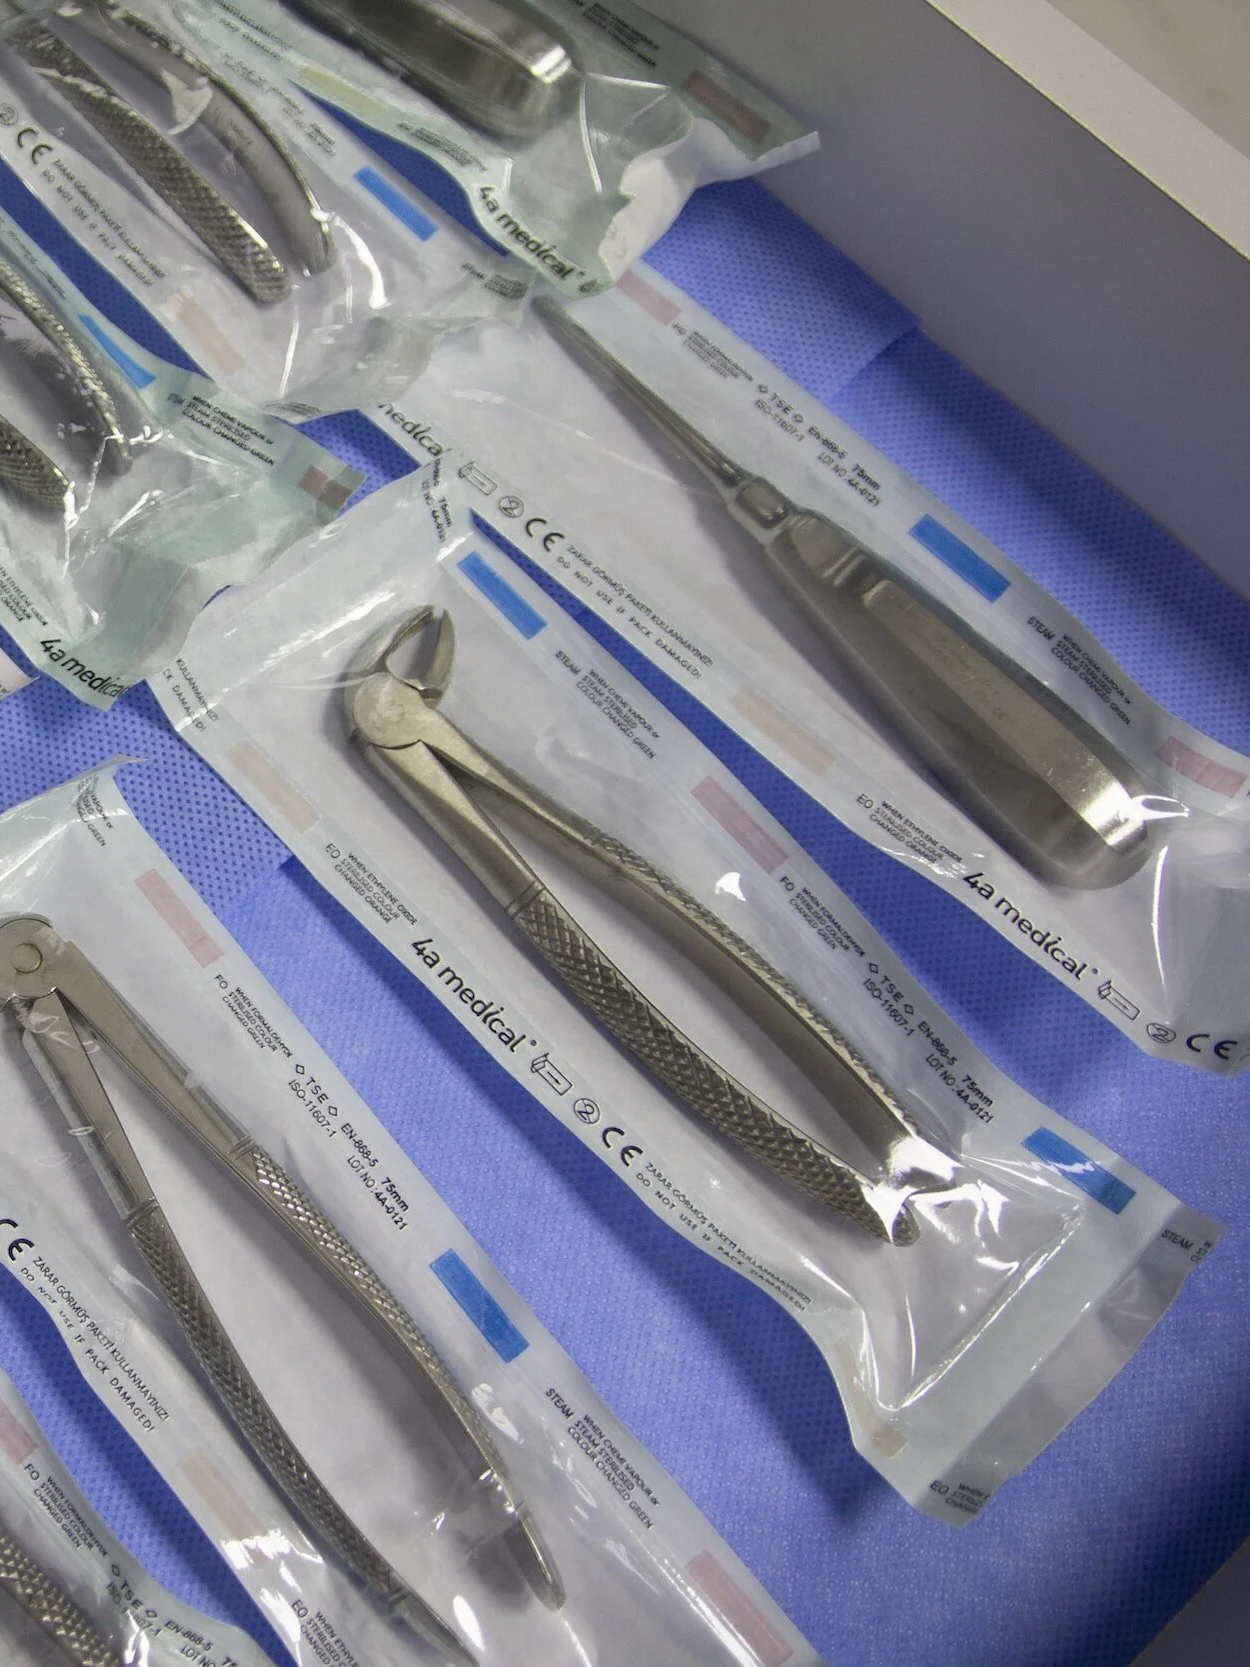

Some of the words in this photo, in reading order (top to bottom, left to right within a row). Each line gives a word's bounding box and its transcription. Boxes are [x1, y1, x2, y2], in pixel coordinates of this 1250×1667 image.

[495, 212, 576, 280] medical
[1026, 615, 1056, 642] STEAM
[39, 638, 67, 663] 4a
[554, 649, 582, 677] STEAM
[581, 674, 606, 698] STEAM
[588, 668, 610, 690] WHEN
[575, 680, 605, 710] COLOUR
[632, 736, 657, 760] GREEN
[855, 792, 875, 810] EO
[324, 842, 342, 860] EO
[333, 863, 367, 897] CHANGED
[363, 894, 393, 925] ORANGE
[347, 851, 369, 875] WHEN
[366, 872, 400, 906] ETHYLENE
[778, 875, 796, 893] FO
[371, 891, 401, 921] COLOUR
[800, 886, 823, 909] WHEN
[824, 924, 851, 953] COLOUR
[962, 871, 996, 901] 4a
[993, 896, 1088, 981] medical
[213, 973, 229, 990] FO
[234, 986, 254, 1009] WHEN
[410, 937, 441, 970] 4a
[436, 965, 527, 1054] medical
[227, 990, 258, 1026] STERILISED
[254, 1023, 279, 1053] COLOUR
[861, 977, 916, 1038] ISO-11607-1
[924, 1052, 946, 1073] LOT
[879, 974, 905, 1004] TSE
[916, 1020, 959, 1067] EN-868-5
[961, 1074, 994, 1108] 75mm
[287, 1078, 338, 1139] ISO-11607-1
[346, 1154, 366, 1174] LOT
[305, 1075, 330, 1105] TSE
[339, 1122, 380, 1168] EN-868-5
[380, 1176, 410, 1213] 75mm
[644, 1161, 673, 1191] ZARAR
[635, 1171, 652, 1188] DO
[654, 1189, 677, 1211] NOT
[678, 1212, 699, 1232] USE
[1160, 1228, 1195, 1251] STEAM
[32, 1255, 60, 1287] ZARAR
[19, 1266, 36, 1282] DO
[36, 1285, 59, 1305] NOT
[58, 1309, 75, 1330] USE
[73, 1333, 86, 1344] IF
[84, 1347, 111, 1376] PACK
[108, 1376, 156, 1433] DAMAGED!
[544, 1387, 575, 1420] STEAM
[23, 1462, 41, 1482] FO
[573, 1419, 601, 1450] STEAM
[594, 1446, 636, 1492] STERILISED
[582, 1413, 606, 1441] WHEN
[623, 1463, 654, 1498] VAPOUR
[46, 1475, 66, 1501] WHEN
[566, 1425, 599, 1463] COLOUR
[594, 1459, 632, 1502] CHANGED
[628, 1500, 655, 1530] GREEN
[32, 1487, 64, 1525] CHANGED
[60, 1522, 83, 1549] GREEN
[38, 1481, 72, 1521] STERILISED
[68, 1518, 95, 1552] COLOUR
[119, 1578, 144, 1611] TSE
[163, 1619, 214, 1652] EN-868-5
[290, 1598, 309, 1619] EO
[179, 1643, 203, 1662] LOT
